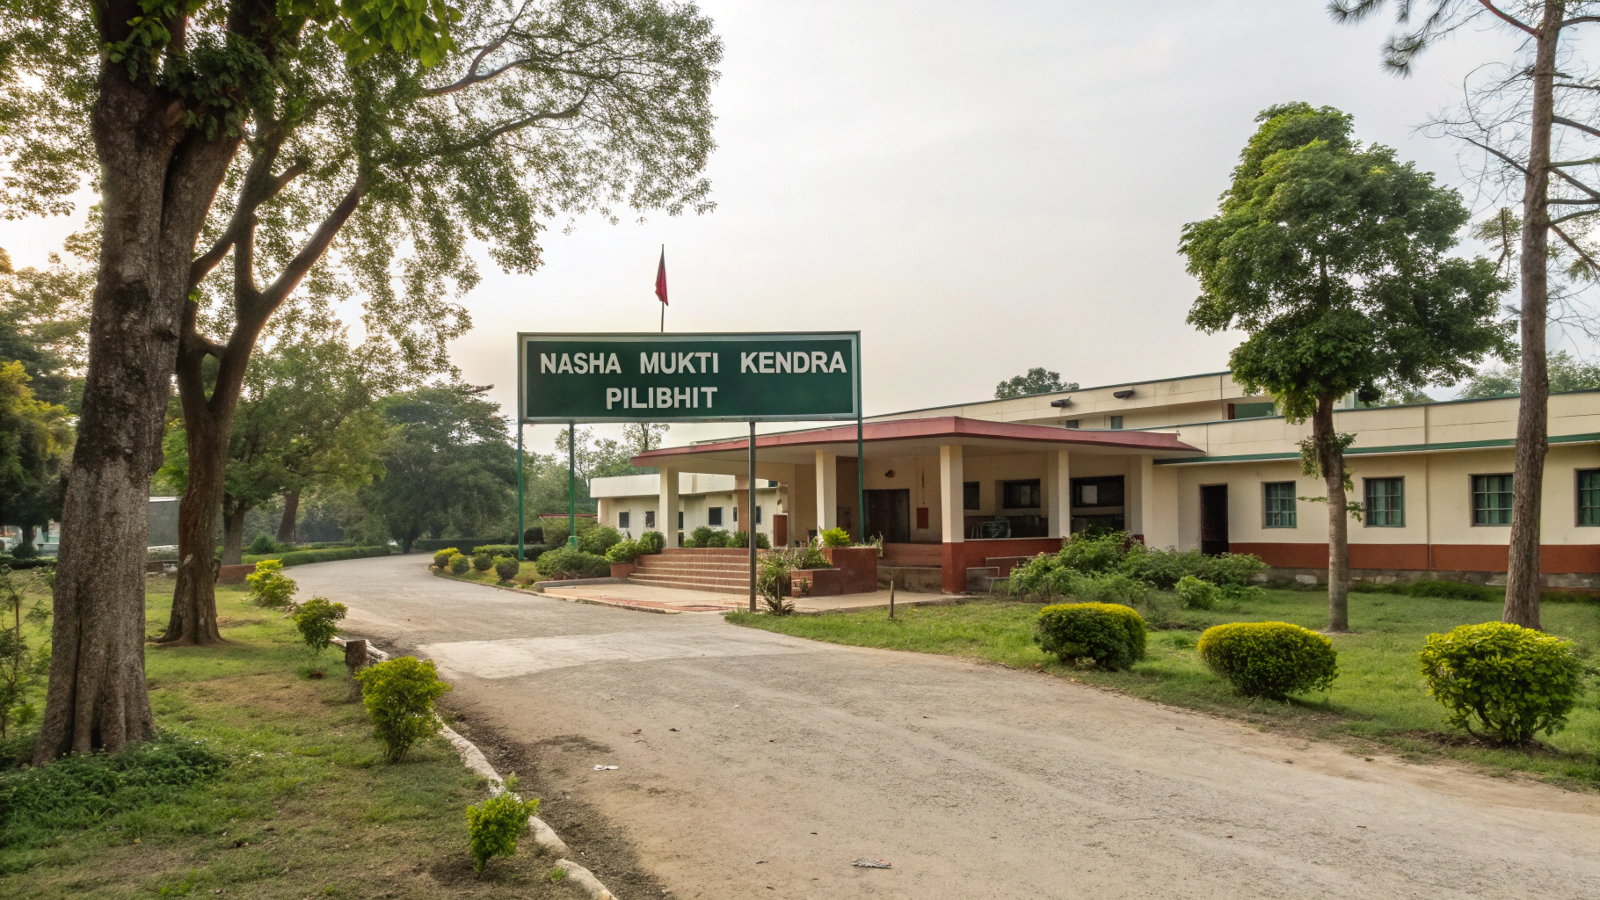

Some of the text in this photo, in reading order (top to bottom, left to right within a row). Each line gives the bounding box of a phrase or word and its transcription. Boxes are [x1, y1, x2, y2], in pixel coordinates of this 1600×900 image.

[540, 351, 847, 374] NASHA MUKTI KENDRA
[606, 387, 718, 410] PILIBHIT
